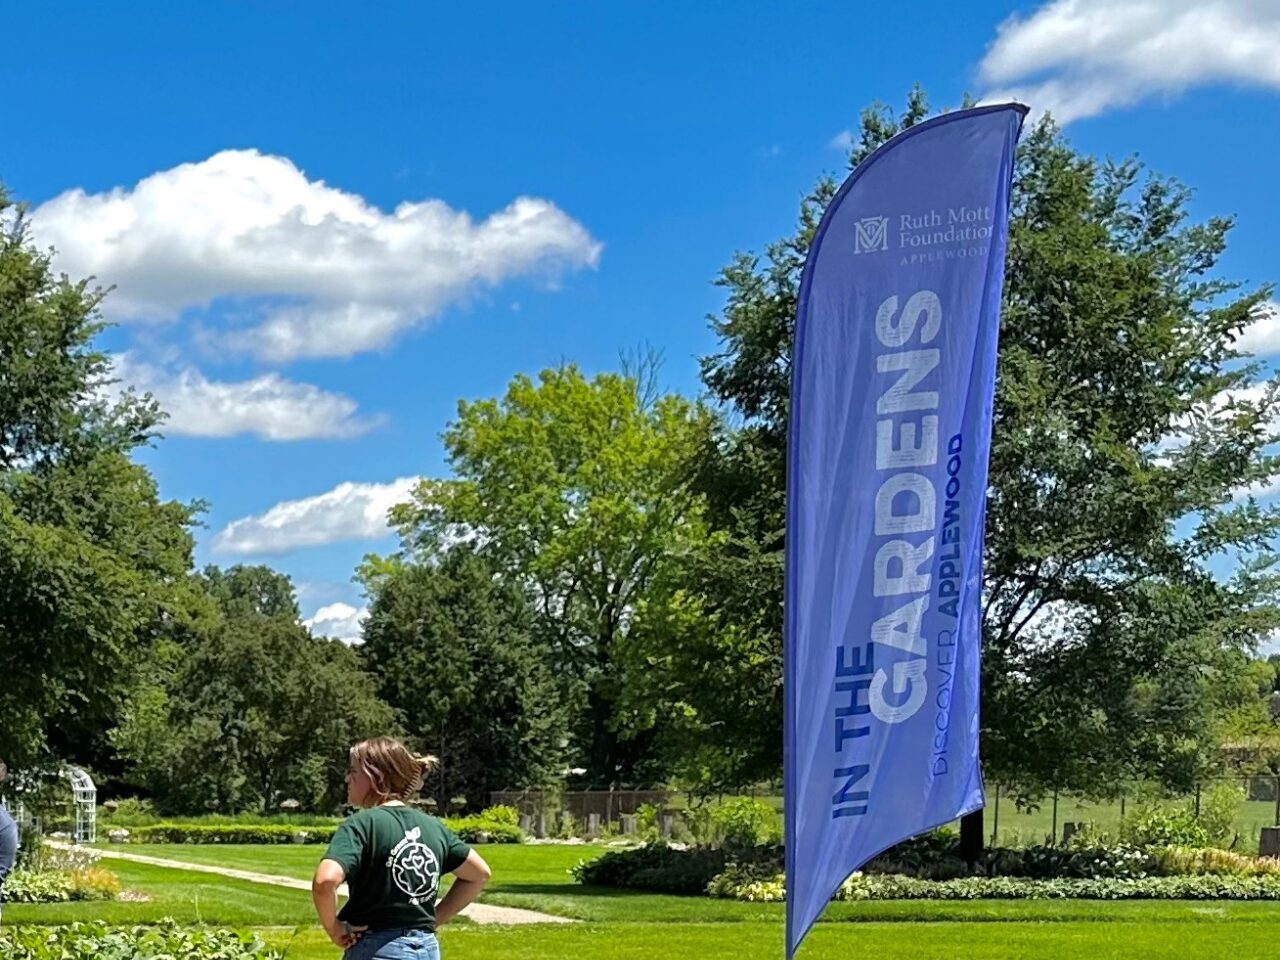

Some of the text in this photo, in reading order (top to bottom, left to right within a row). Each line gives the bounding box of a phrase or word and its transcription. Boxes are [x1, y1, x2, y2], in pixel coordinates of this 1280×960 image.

[900, 207, 990, 231] Ruth Mott
[900, 246, 988, 266] APPLEWOOD
[868, 290, 943, 724] GARDENS
[932, 433, 963, 777] DISCOVER APPLEWOOD
[832, 642, 874, 819] IN THE
